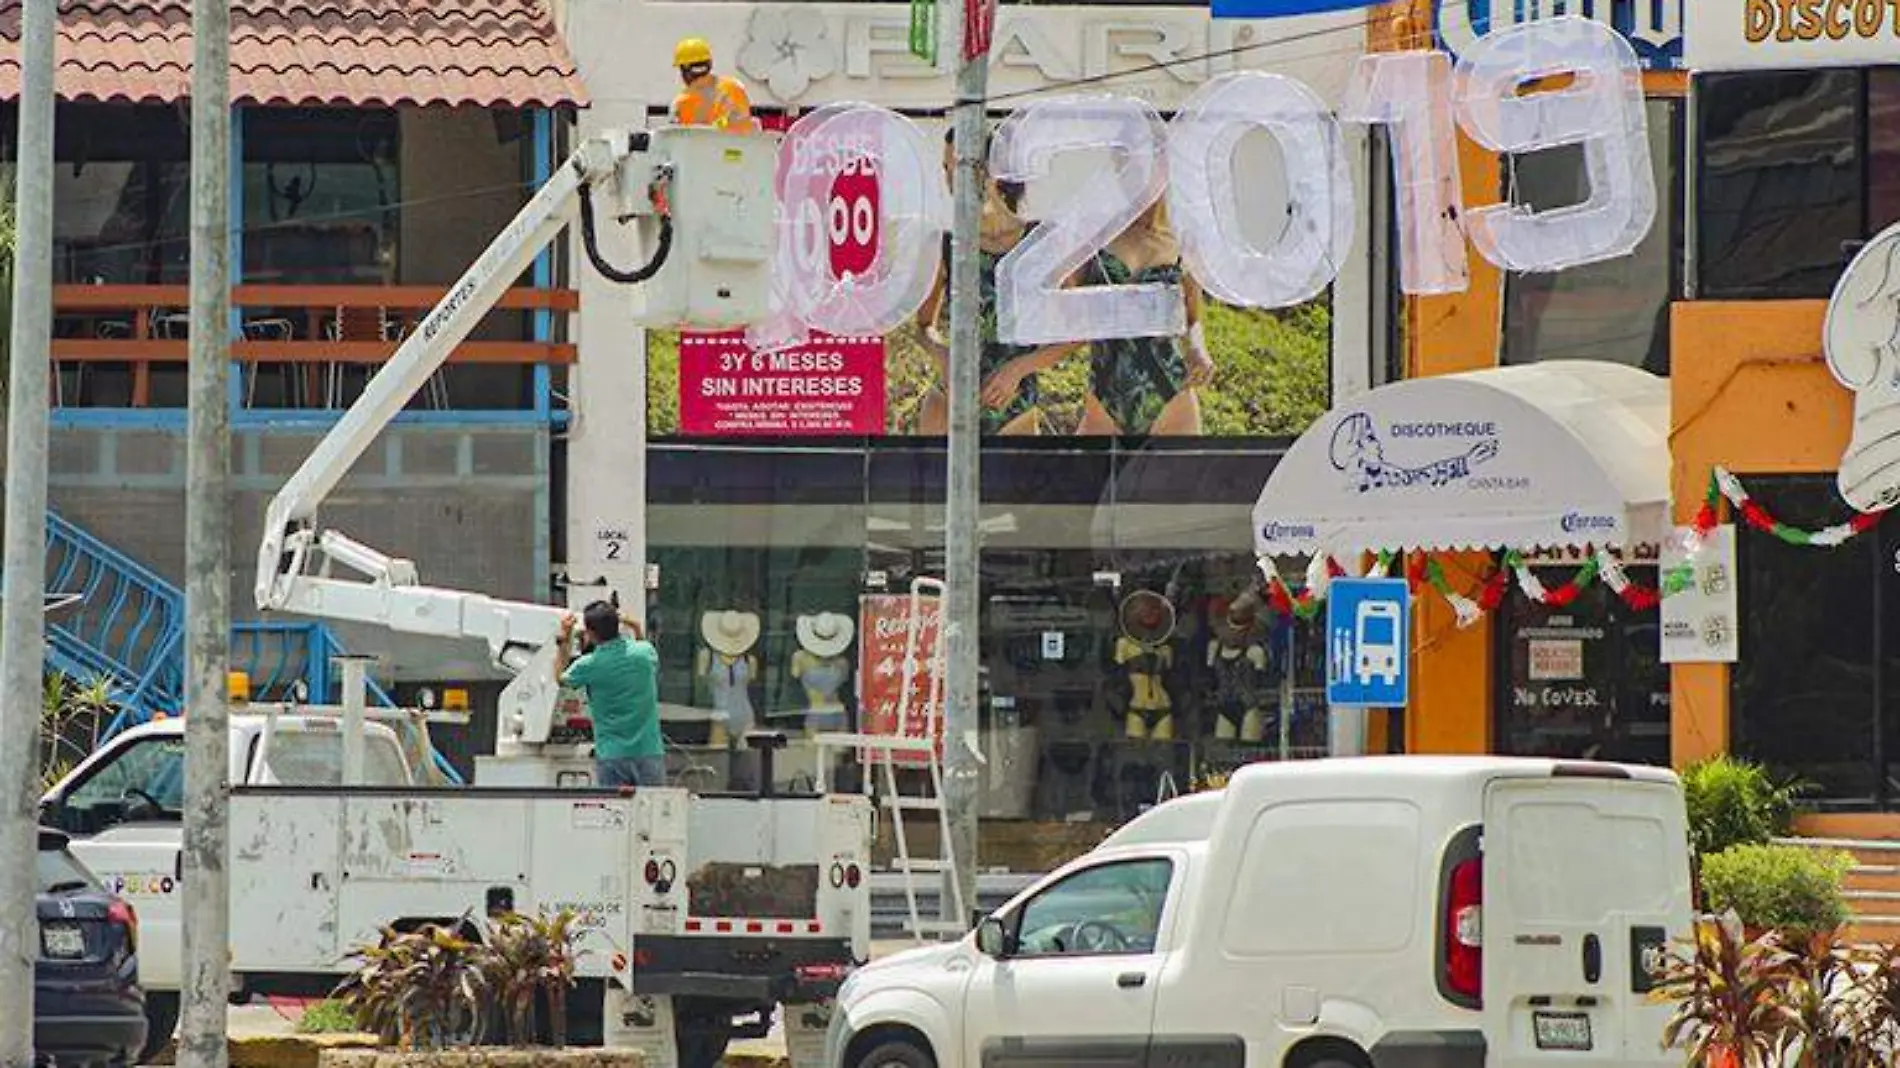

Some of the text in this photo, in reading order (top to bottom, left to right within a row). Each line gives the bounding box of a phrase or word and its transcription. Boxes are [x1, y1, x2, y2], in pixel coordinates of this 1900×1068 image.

[988, 15, 1657, 345] 2019
[769, 353, 844, 371] MESES
[702, 376, 862, 396] SIN INTERESES
[1391, 422, 1496, 438] DISCOTHEQUE
[1262, 521, 1315, 541] Corona
[1561, 512, 1616, 532] Corona
[606, 541, 620, 559] 2
